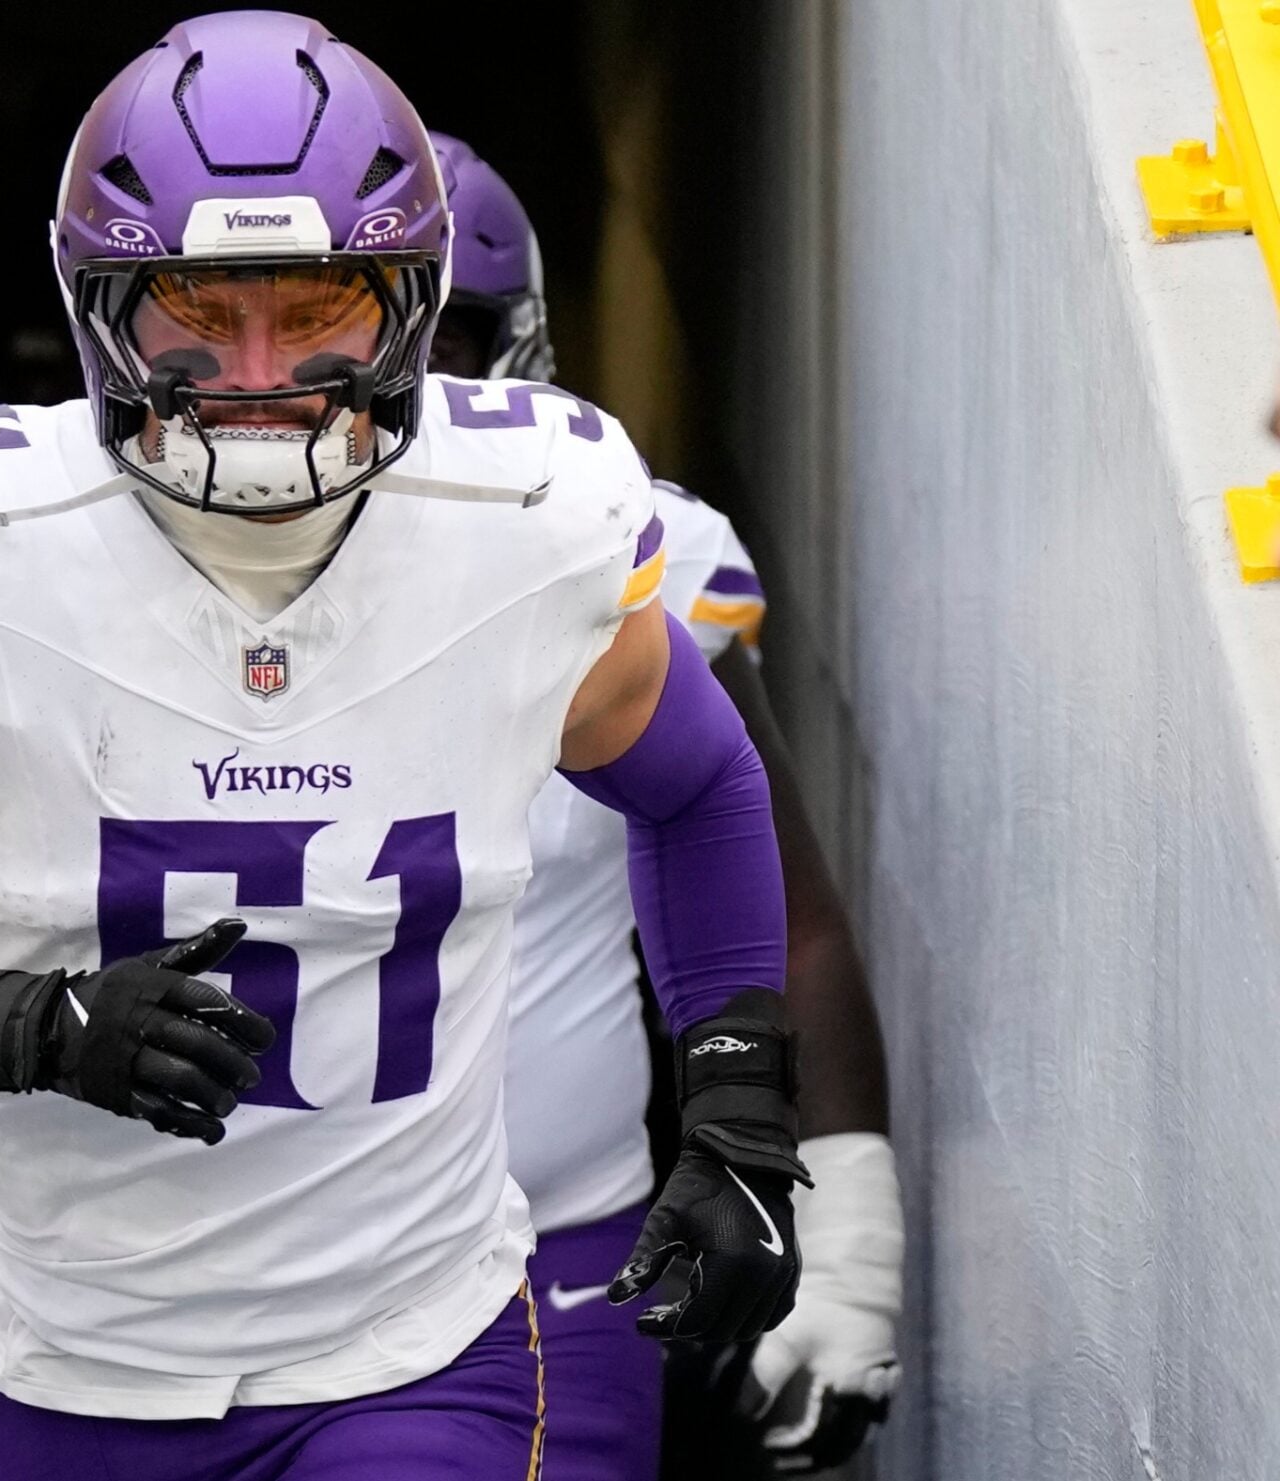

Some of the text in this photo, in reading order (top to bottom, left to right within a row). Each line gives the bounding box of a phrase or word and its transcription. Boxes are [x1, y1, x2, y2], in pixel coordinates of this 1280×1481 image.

[223, 208, 293, 231] VIKINGS
[105, 237, 155, 254] OAKLEY
[355, 227, 404, 249] OAKLEY
[250, 665, 284, 690] NFL
[192, 746, 352, 800] VIKINGS
[96, 810, 463, 1111] 51
